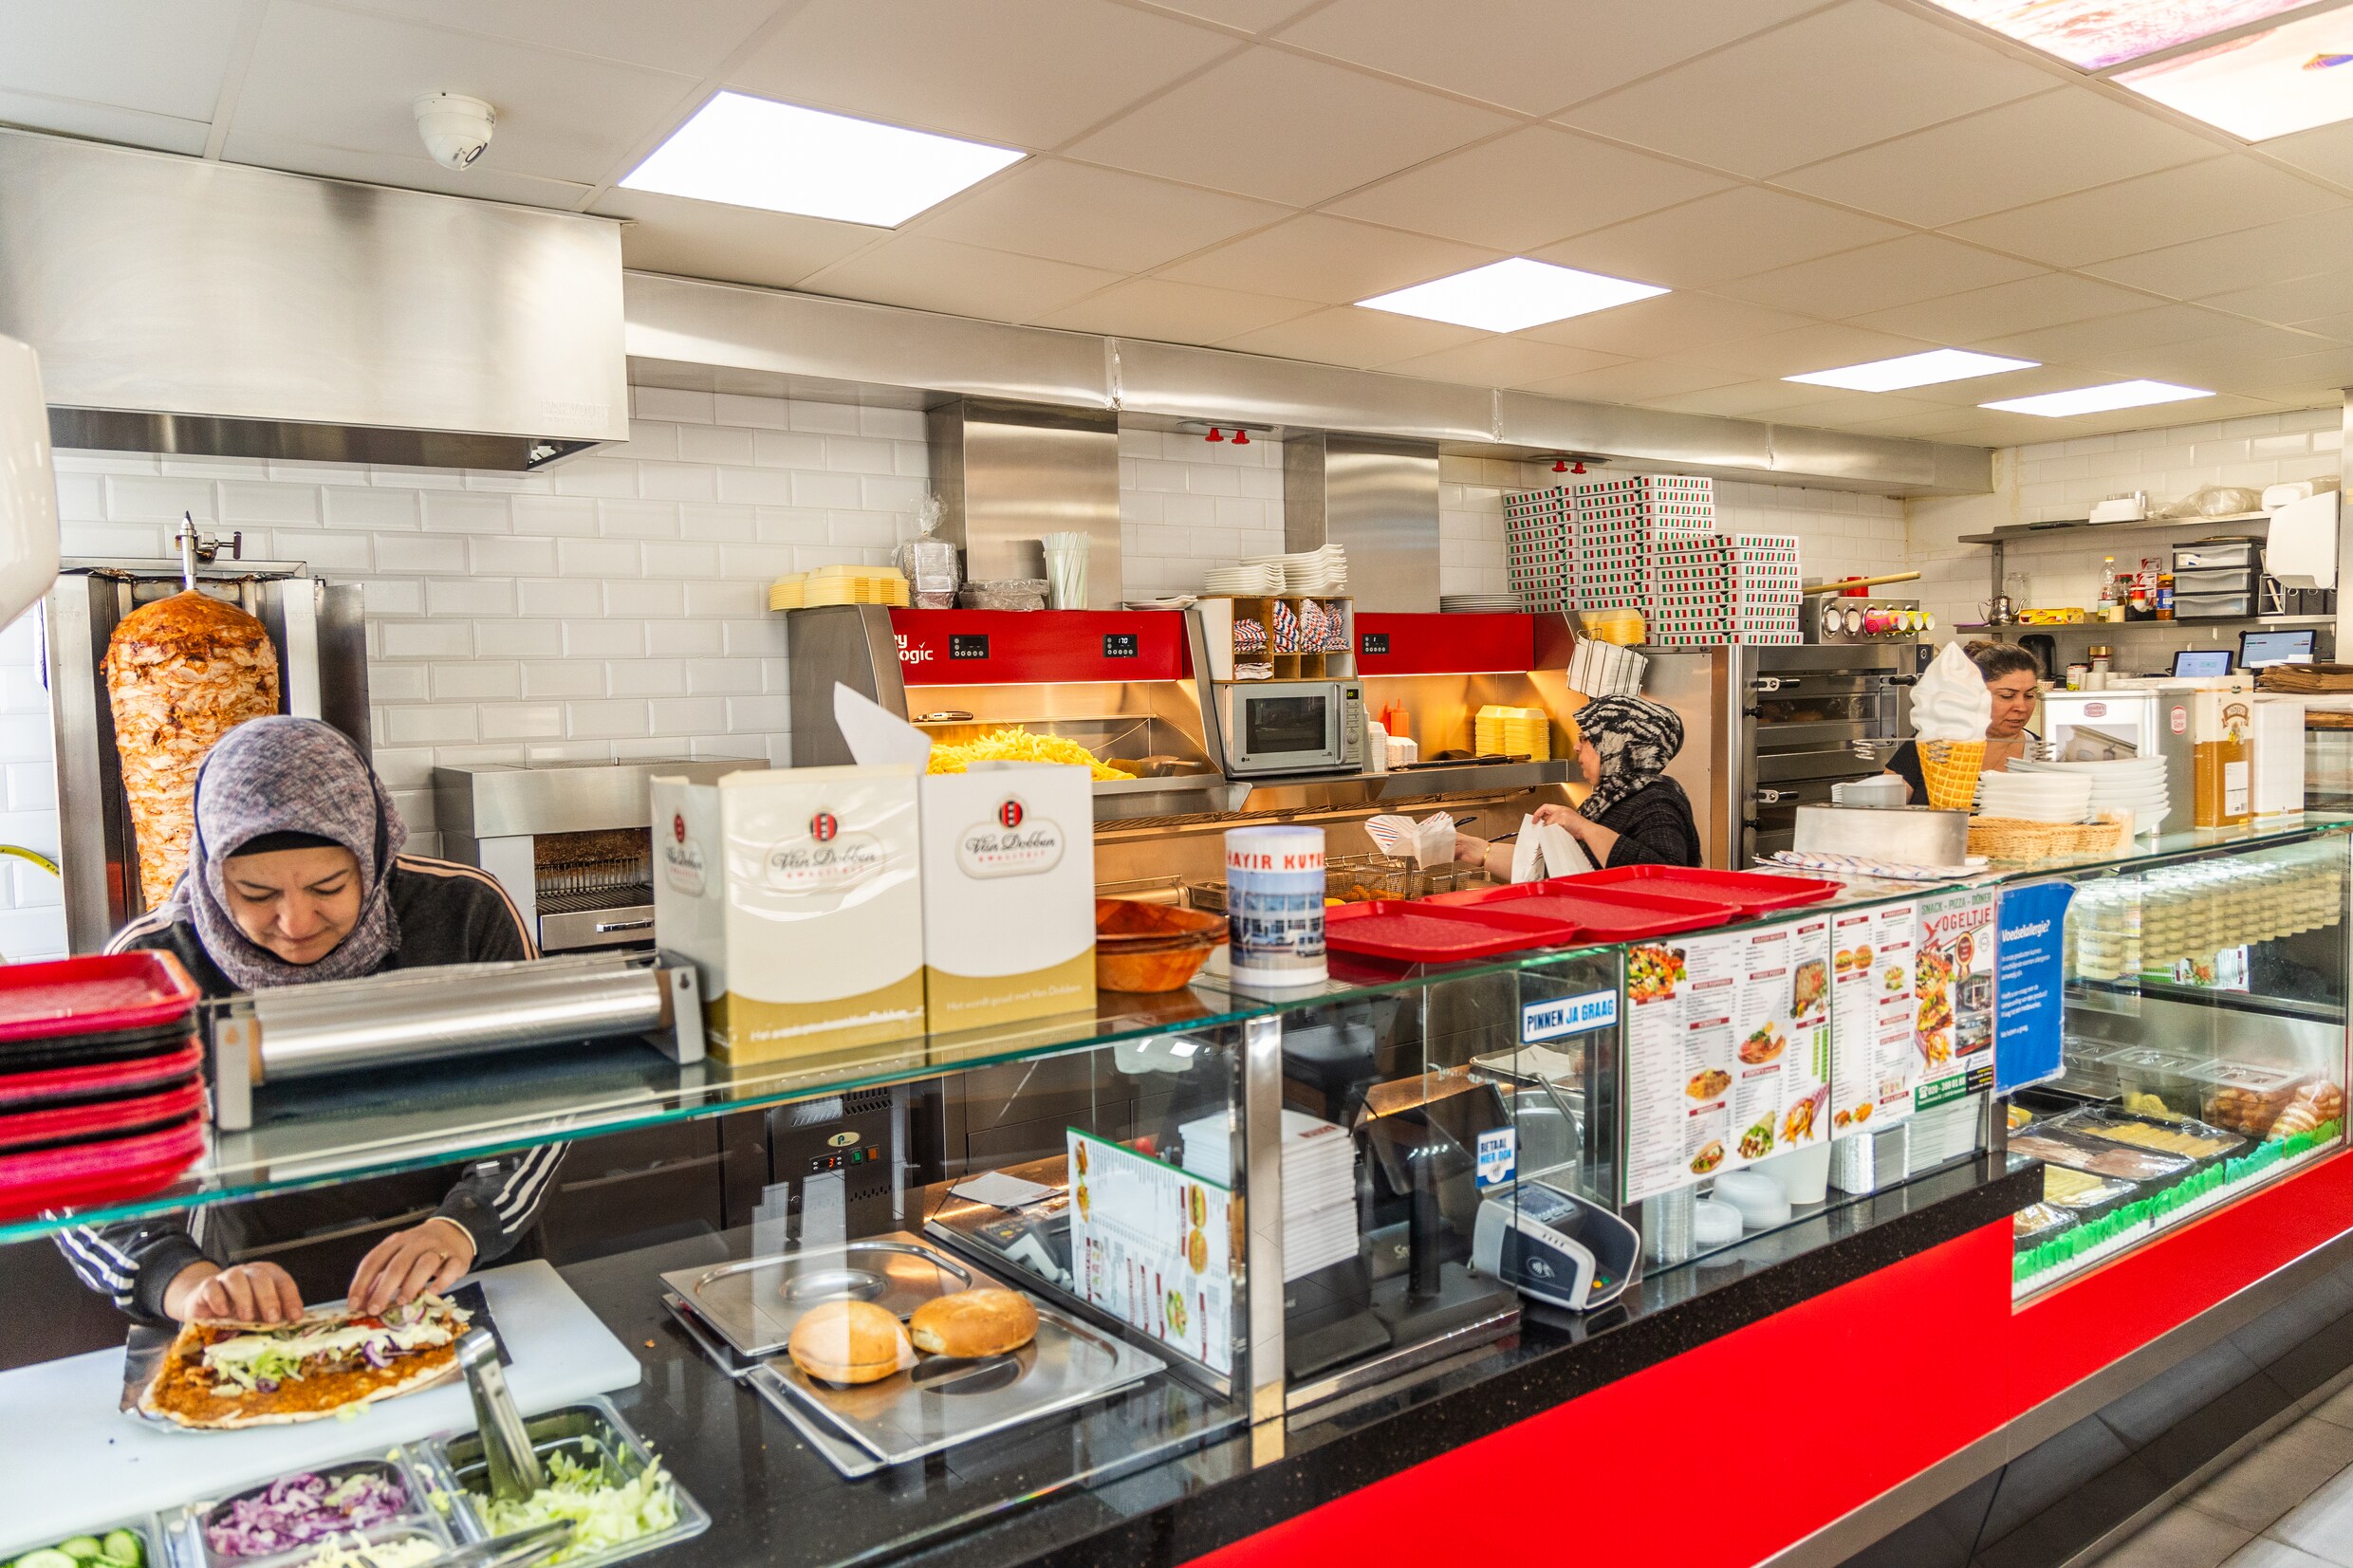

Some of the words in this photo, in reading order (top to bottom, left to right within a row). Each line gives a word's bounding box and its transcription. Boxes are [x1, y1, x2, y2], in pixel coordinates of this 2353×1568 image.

[965, 835, 998, 854] Van
[1000, 830, 1055, 851] Dobben
[770, 849, 809, 871] Van
[1921, 902, 1943, 915] SNACK
[1948, 897, 1966, 910] PIZZA
[1972, 893, 1992, 906] DÖNER
[2002, 919, 2050, 942] Voedselallergie?
[1528, 1008, 1564, 1033] PINNEN
[1566, 1006, 1579, 1024] JA
[1582, 999, 1613, 1021] GRAAG
[828, 1157, 835, 1168] 3
